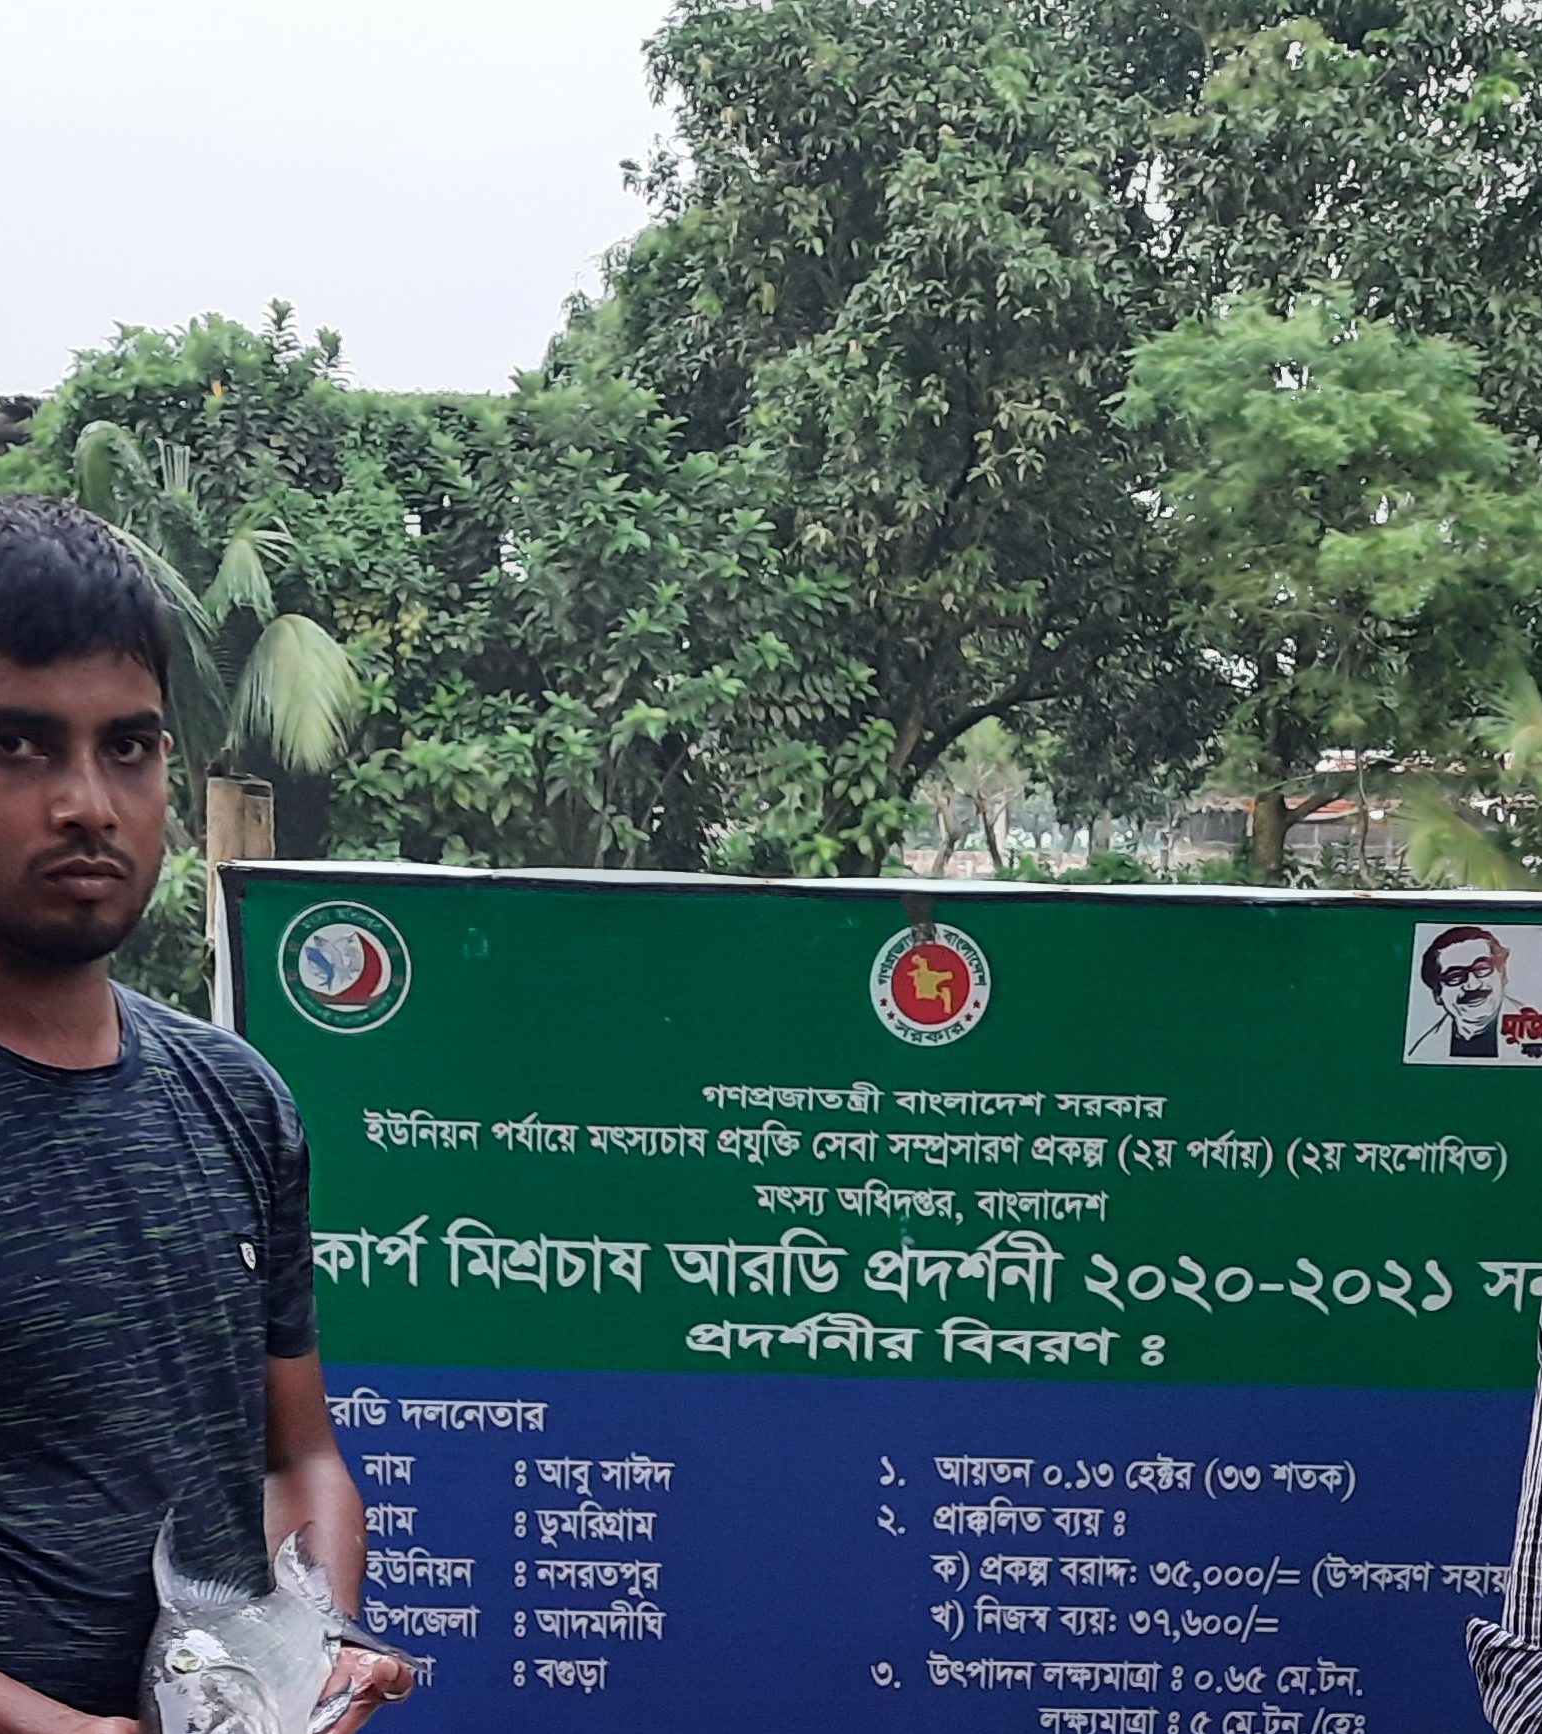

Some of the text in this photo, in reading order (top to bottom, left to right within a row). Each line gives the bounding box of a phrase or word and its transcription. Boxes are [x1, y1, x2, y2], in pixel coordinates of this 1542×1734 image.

[702, 1081, 1167, 1119] গণপ্রজাতন্ত্রী বাংলাদেশ সরকার
[363, 1109, 1507, 1176] ইউনিয়ন পর্যায়ে মৎস্যচাষ প্রযুক্তি সেবা সম্প্রসারণ প্রকল্প (২য় পর্যায়) (২য় সংশোধিত)
[754, 1178, 1108, 1223] মৎস্য অধিদপ্তর, বাংলাদেশ
[311, 1214, 429, 1286] কার্প
[441, 1217, 651, 1292] মিশ্রচাষ
[665, 1227, 848, 1296] আরডি
[864, 1230, 1064, 1302] প্রদর্শনী
[1084, 1253, 1453, 1315] ২০২০-২০২১
[686, 1312, 923, 1361] প্রদর্শনীর
[935, 1316, 1120, 1365] বিবরণ
[325, 1386, 549, 1433] রডি দলনেতার
[362, 1452, 415, 1485] নাম
[535, 1457, 594, 1497] আবু
[598, 1452, 676, 1491] সাঈদ
[934, 1454, 1035, 1487] আয়তন
[1043, 1460, 1114, 1489] ০.১৩
[1125, 1453, 1196, 1493] হেক্টর
[1204, 1458, 1261, 1499] (৩৩
[1270, 1461, 1356, 1501] শতক)
[364, 1503, 418, 1536] গ্রাম
[534, 1500, 657, 1548] ডুমরিগ্রাম
[1051, 1507, 1104, 1537] ব্যয়
[365, 1547, 475, 1588] ইউনিয়ন
[534, 1559, 662, 1599] নসরতপুর
[930, 1550, 970, 1591] ক)
[980, 1553, 1053, 1587] প্রকল্প
[1149, 1556, 1301, 1594] ৩৫,০০০/=
[1312, 1552, 1435, 1597] (উপকরণ
[1440, 1562, 1511, 1598] সহায়
[362, 1597, 481, 1641] উপজেলা
[534, 1599, 666, 1640] আদমদীঘি
[930, 1599, 964, 1640] খ)
[973, 1594, 1051, 1633] নিজস্ব
[1128, 1604, 1279, 1643] ৩৭,৬০০/=
[533, 1657, 608, 1694] বগুড়া
[926, 1650, 1036, 1689] উৎপাদন
[1041, 1661, 1162, 1692] লক্ষ্যমাত্রা
[1194, 1665, 1265, 1693] ০.৬৫
